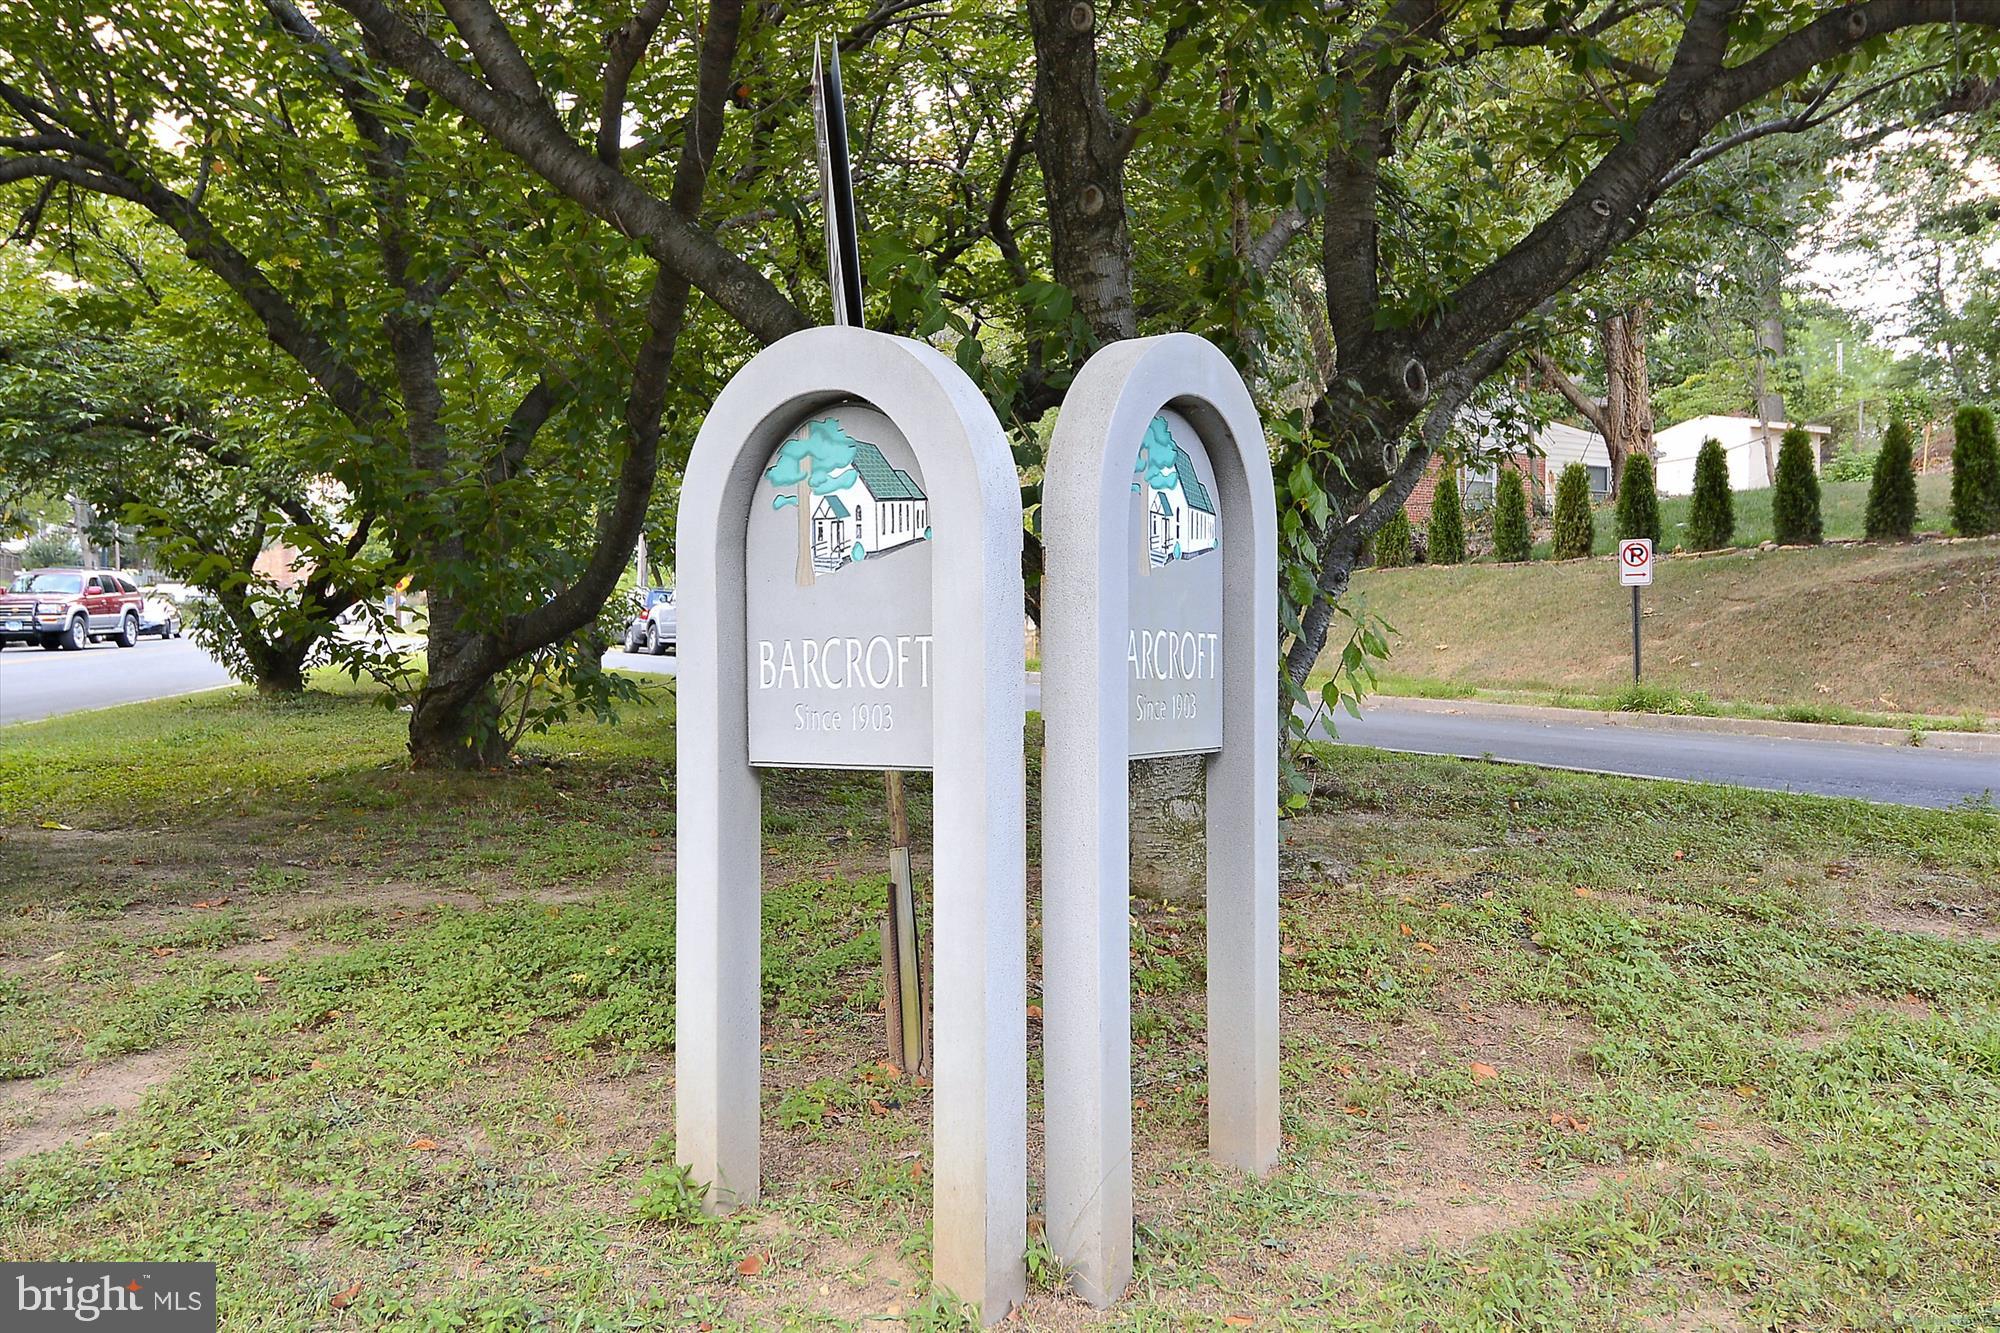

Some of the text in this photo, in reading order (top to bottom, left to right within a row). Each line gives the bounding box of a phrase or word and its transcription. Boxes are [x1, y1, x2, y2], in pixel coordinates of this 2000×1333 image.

[759, 635, 933, 690] BARCROFT
[1127, 629, 1218, 681] ARCROFT
[794, 703, 894, 732] Since 1903
[1136, 692, 1197, 721] Since 1903
